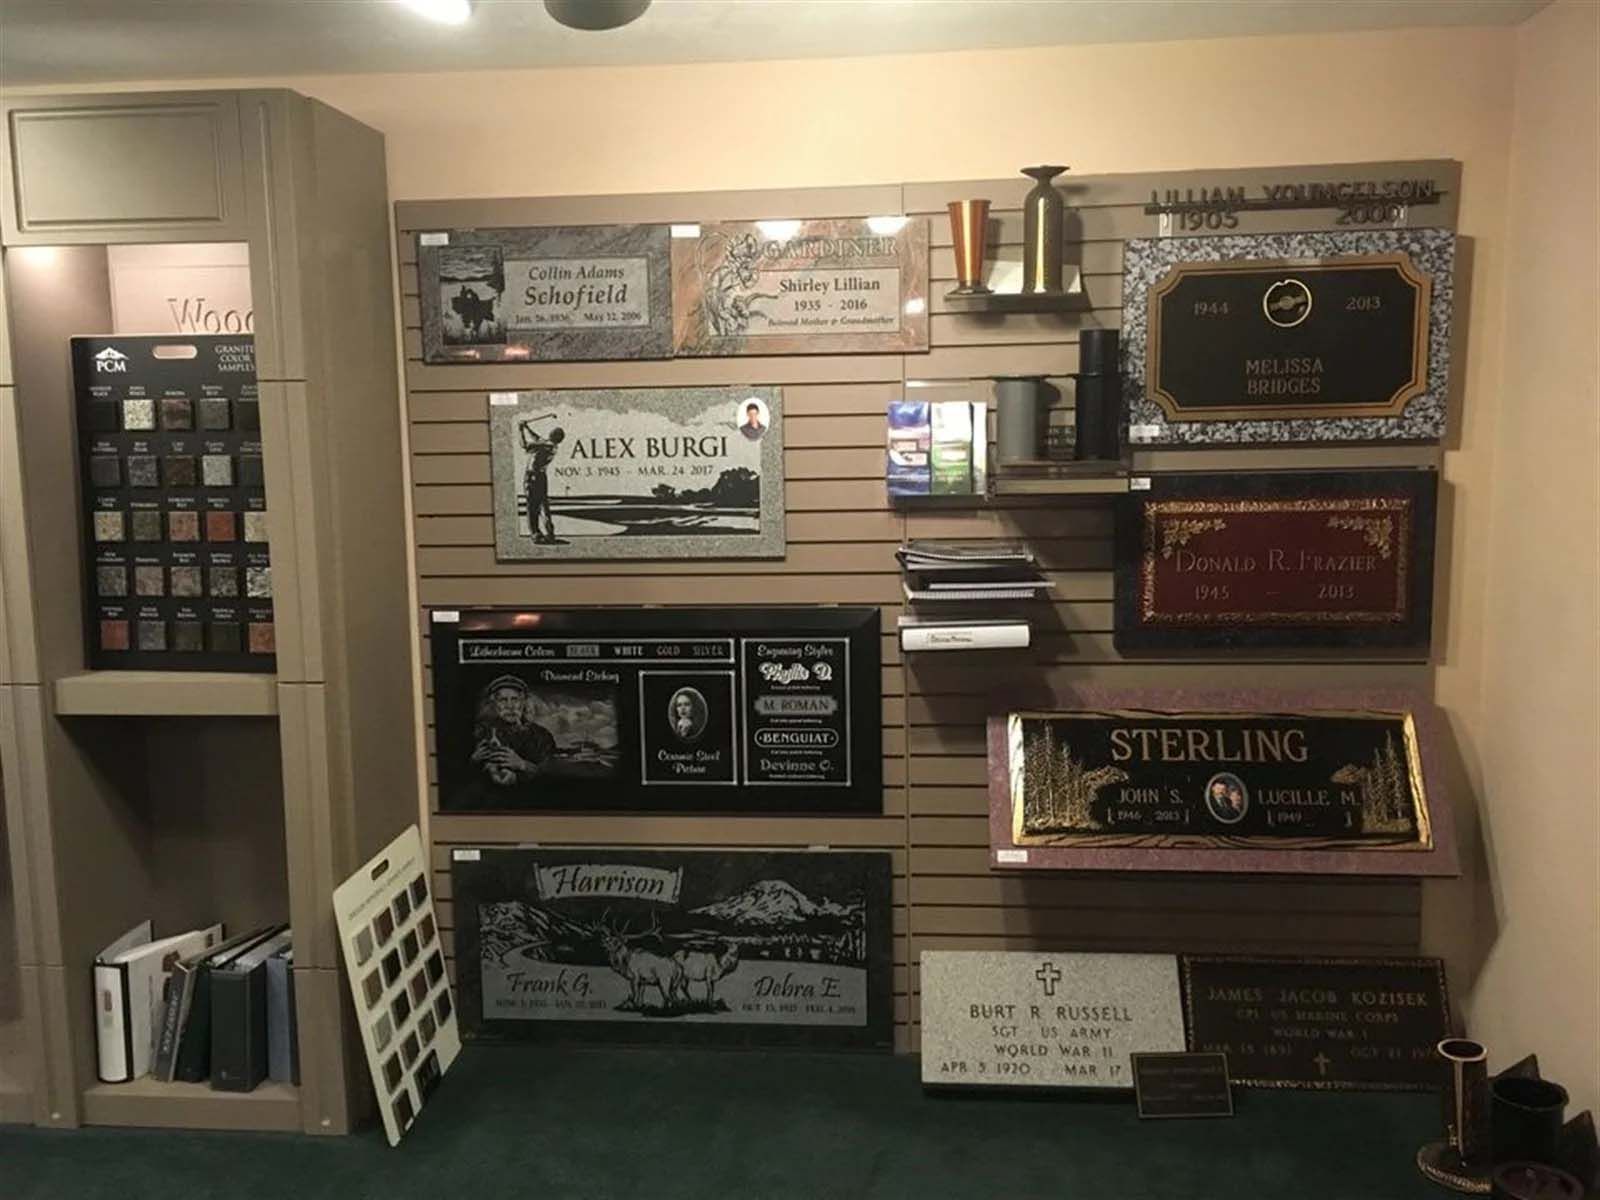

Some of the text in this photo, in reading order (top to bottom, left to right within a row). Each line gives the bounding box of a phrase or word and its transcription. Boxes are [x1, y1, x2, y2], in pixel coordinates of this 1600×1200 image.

[1179, 209, 1239, 231] 1905
[762, 238, 899, 260] GARDINER
[528, 264, 624, 281] Collin Adams
[779, 276, 881, 296] Shirley Lillian
[523, 283, 629, 310] Schofield
[794, 300, 822, 312] 1935
[839, 298, 869, 311] 2016
[1193, 296, 1382, 316] 1944 2013
[96, 359, 128, 373] PCM
[220, 353, 251, 363] COLOR
[1245, 358, 1325, 376] MELISSA
[1246, 377, 1321, 395] BRIDGES
[570, 436, 729, 460] ALEX BURGI
[689, 464, 714, 476] 2017
[1268, 548, 1290, 572] R.
[1195, 585, 1230, 601] 1945
[1317, 583, 1356, 600] 2013
[613, 645, 644, 656] WHITE
[656, 645, 681, 657] GOLD
[692, 644, 724, 657] SILVER
[758, 661, 810, 685] Phyllis
[782, 697, 830, 711] ROMAN
[763, 732, 830, 744] BENGUIAT
[1109, 728, 1308, 765] STERLING
[759, 758, 816, 772] Devinne
[1119, 787, 1184, 805] JOHN S.
[1258, 788, 1330, 806] LUCILLE
[551, 868, 666, 896] Harrison
[506, 967, 593, 998] Frank G.
[753, 972, 815, 998] Debra
[1207, 987, 1428, 1007] JAMES JACOB KOZISEK
[969, 1003, 1133, 1022] BURT R RUSSELL
[1296, 1010, 1348, 1023] MARINE
[1355, 1011, 1400, 1024] CORPS
[991, 1025, 1111, 1040] SGT US ARMY
[994, 1044, 1049, 1058] WORLD
[1058, 1044, 1091, 1058] WAR
[940, 1061, 968, 1075] APR
[996, 1062, 1031, 1075] 1920
[1063, 1064, 1097, 1077] MAR
